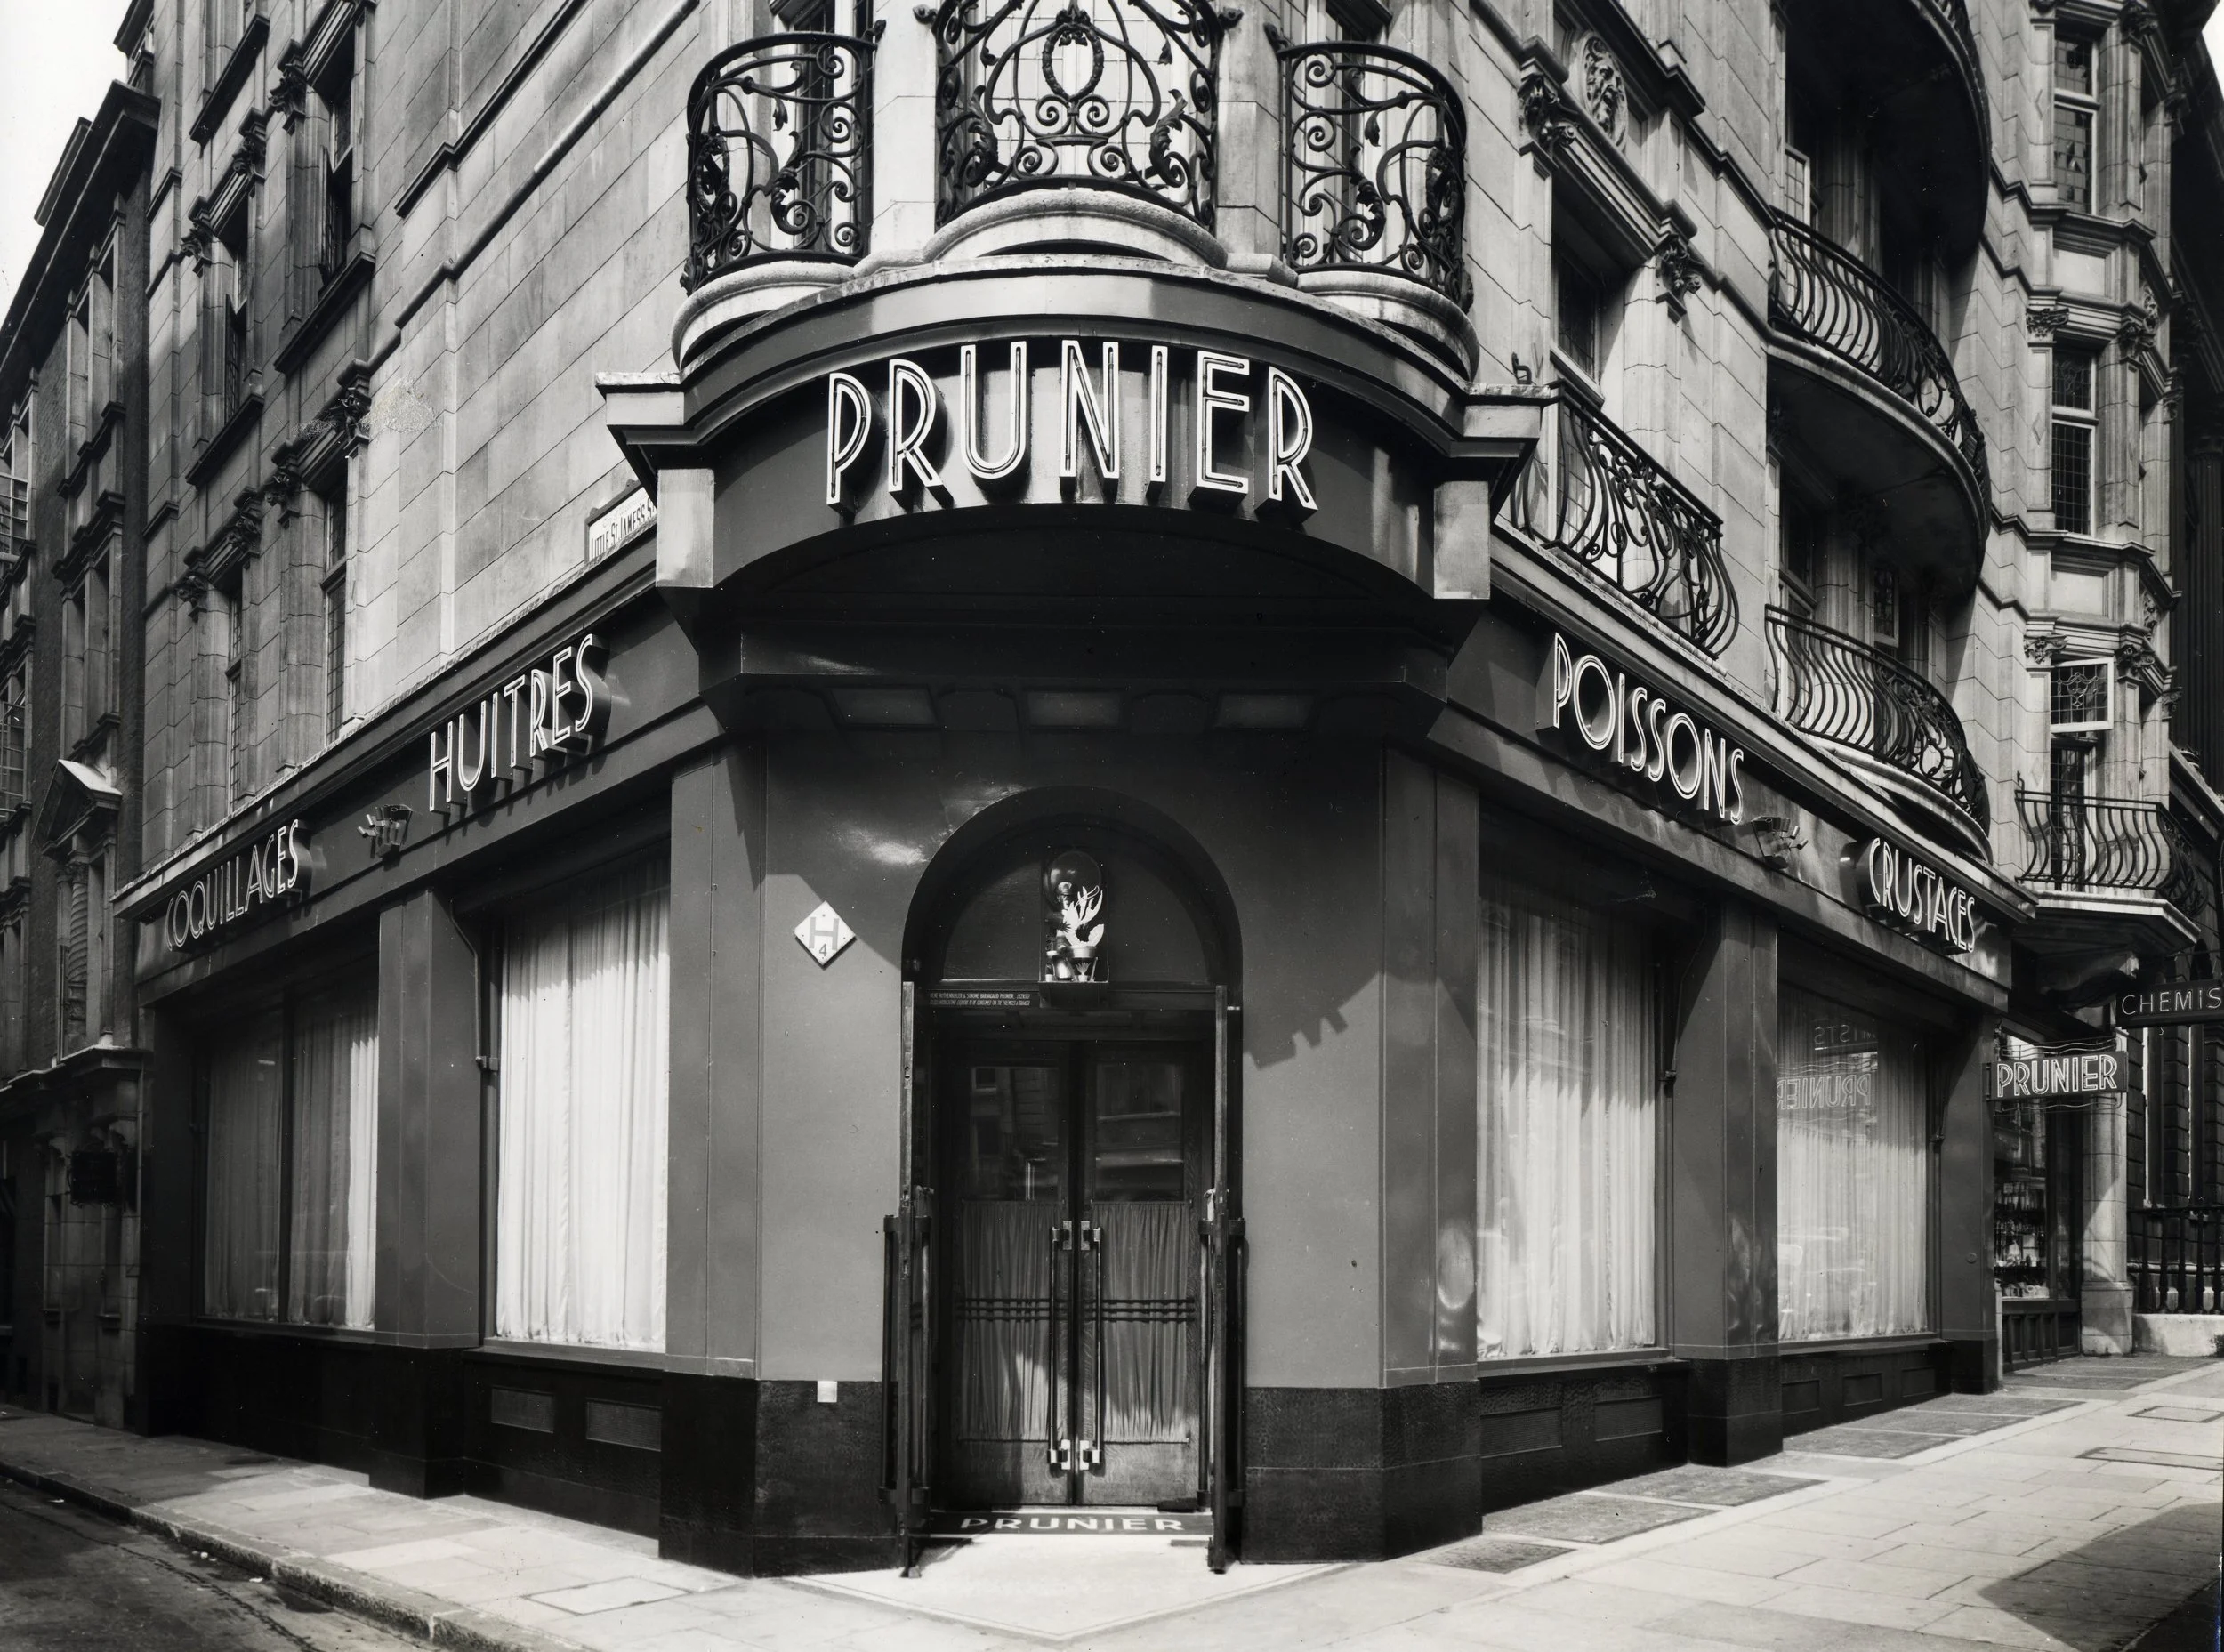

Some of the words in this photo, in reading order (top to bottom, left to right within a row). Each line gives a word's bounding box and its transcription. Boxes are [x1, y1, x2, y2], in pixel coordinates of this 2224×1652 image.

[826, 339, 1317, 511] PRUNIER
[430, 633, 593, 812] HUITRES
[1553, 632, 1744, 825] POISSONS
[165, 819, 299, 952] COQUILLAGES
[809, 916, 839, 950] H
[1869, 837, 1976, 953] CRUSTACES
[818, 943, 827, 957] 4
[1996, 1054, 2118, 1098] PRUNIER
[960, 1517, 1185, 1531] PRUNIER
